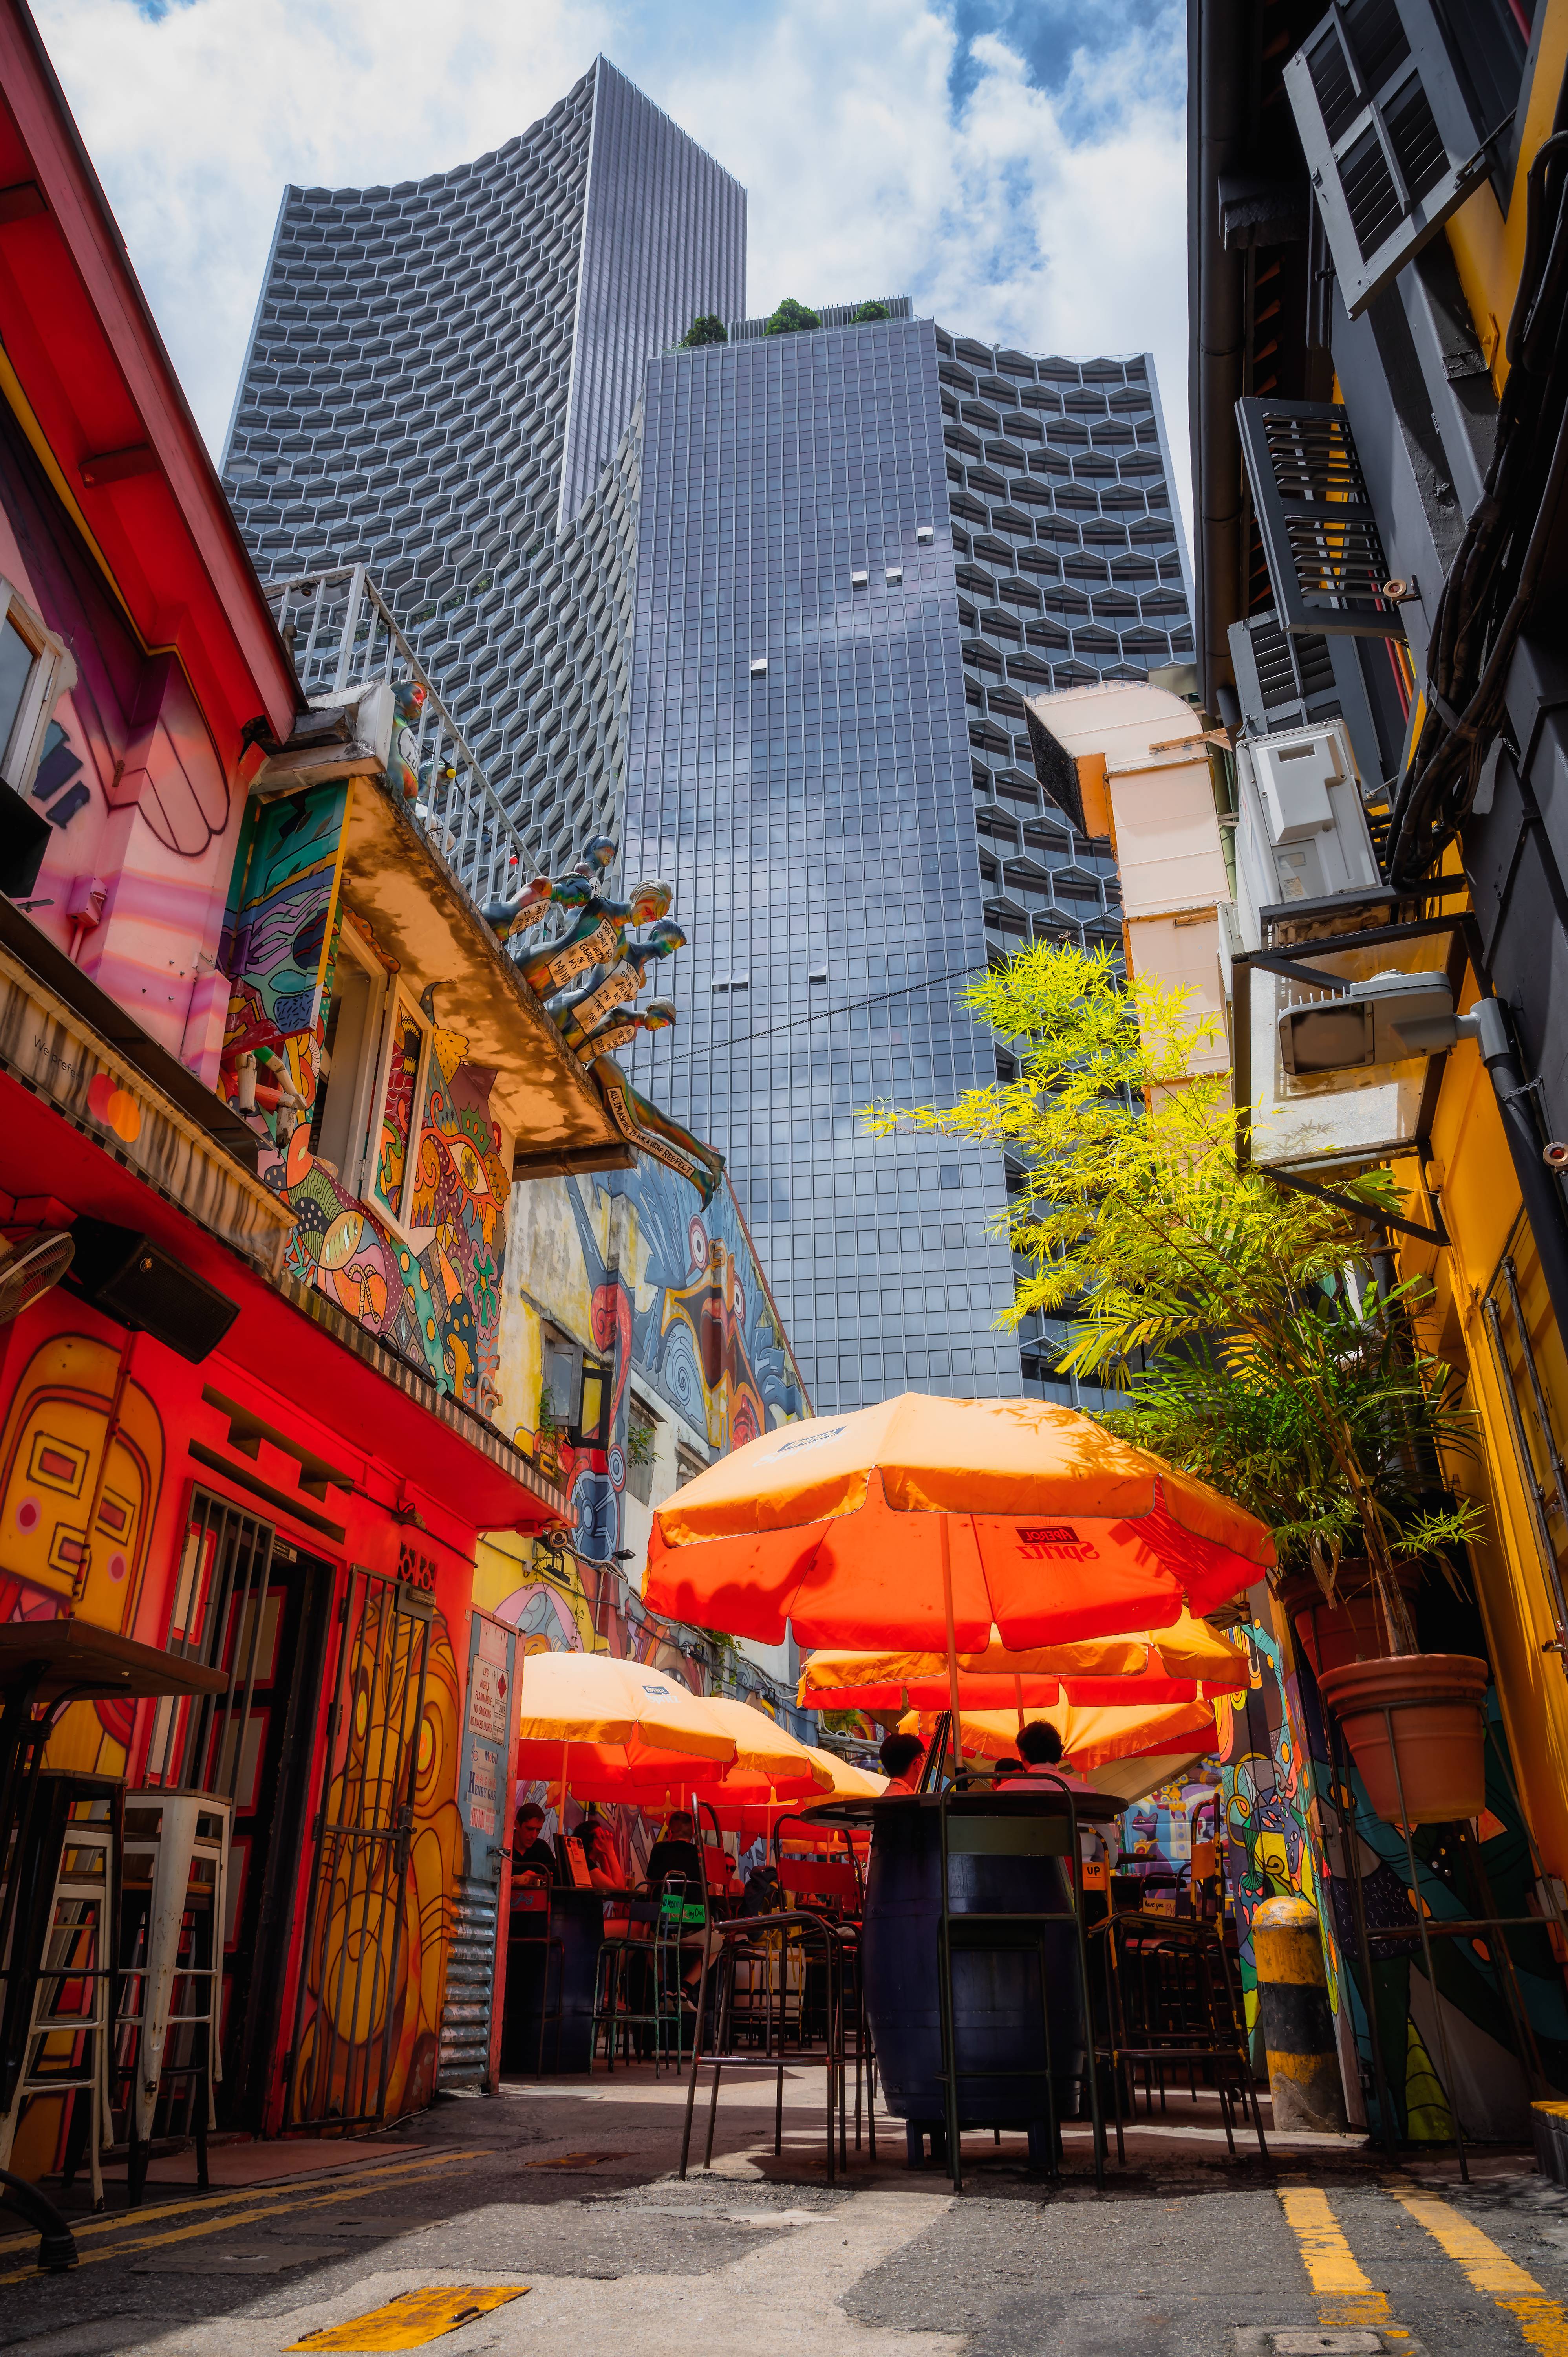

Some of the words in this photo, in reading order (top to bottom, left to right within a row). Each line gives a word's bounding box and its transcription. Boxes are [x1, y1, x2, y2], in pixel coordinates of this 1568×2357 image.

[602, 921, 611, 936] JUST
[568, 958, 580, 970] MY
[626, 963, 634, 975] YOU
[554, 960, 571, 982] MIND
[598, 989, 611, 1003] I'M
[587, 1013, 598, 1024] ONE
[35, 1035, 49, 1056] We
[51, 1053, 80, 1080] prefer
[609, 1090, 619, 1102] ALL
[613, 1101, 623, 1112] I'M
[617, 1112, 631, 1131] ASKING
[629, 1128, 637, 1137] IS
[636, 1134, 645, 1143] FOR
[650, 1141, 663, 1153] LITTLE
[662, 1149, 693, 1174] RESPECT
[480, 1679, 490, 1691] HIGHLY
[475, 1690, 492, 1706] FLAMMABLE
[474, 1703, 478, 1713] NO
[479, 1705, 491, 1719] SMOKING
[470, 1716, 474, 1725] NO
[474, 1717, 483, 1729] NAKED
[483, 1721, 492, 1733] LIGHTS
[485, 1751, 498, 1764] Mobil
[488, 1789, 496, 1801] GAS
[1087, 1866, 1100, 1876] UP
[1156, 1903, 1164, 1911] you
